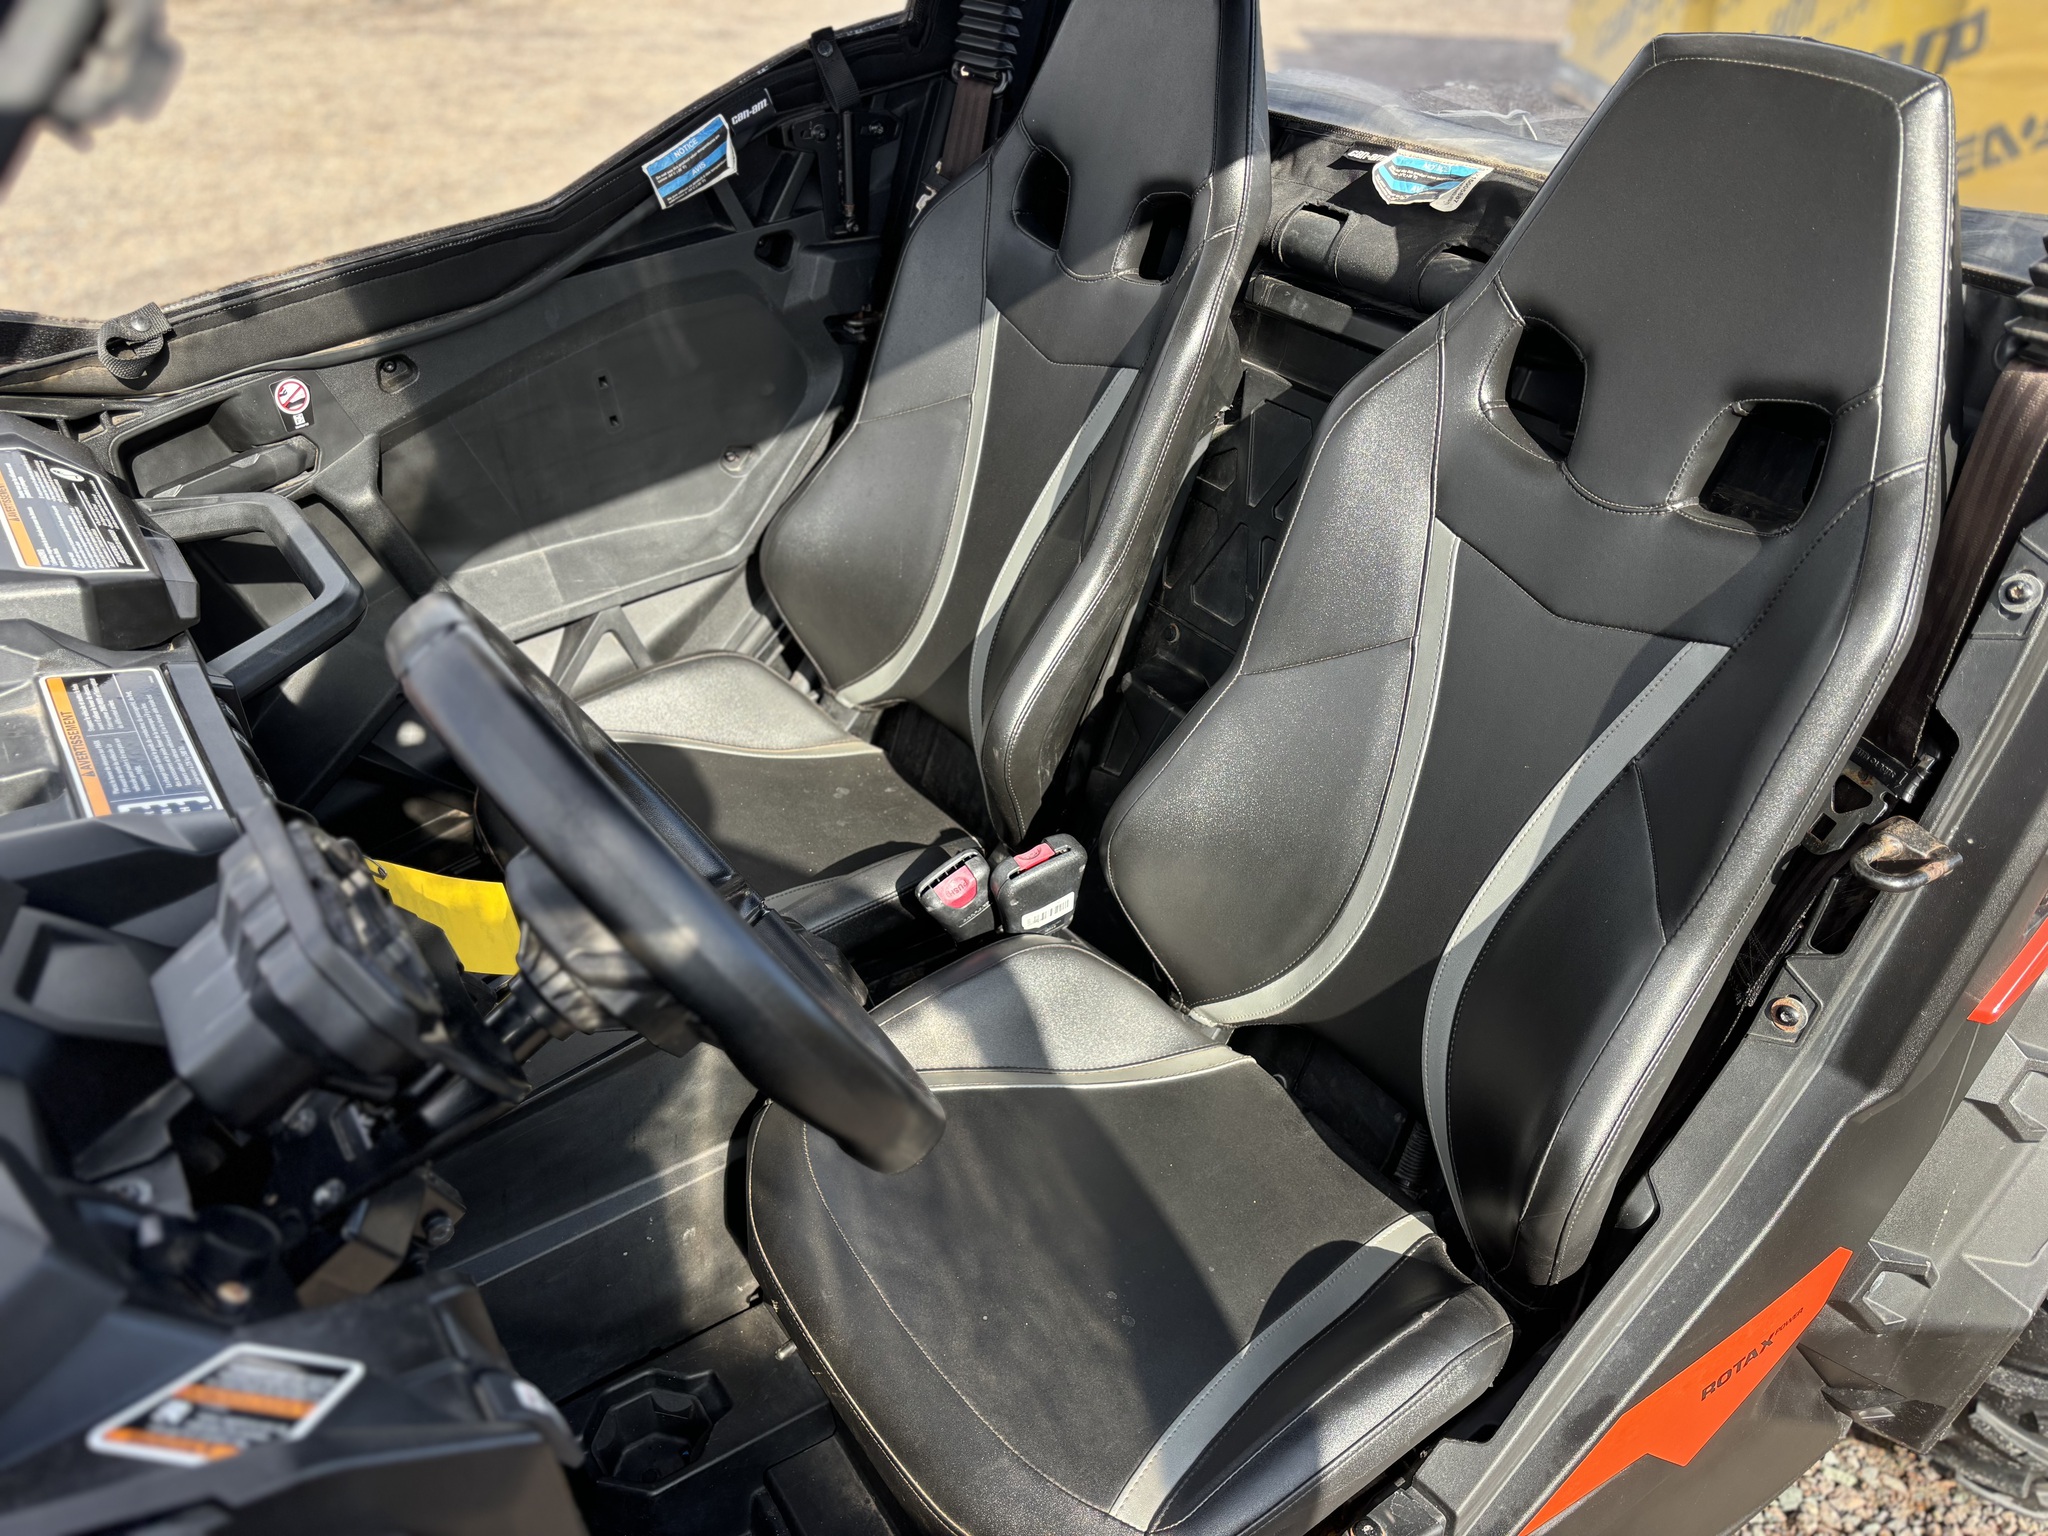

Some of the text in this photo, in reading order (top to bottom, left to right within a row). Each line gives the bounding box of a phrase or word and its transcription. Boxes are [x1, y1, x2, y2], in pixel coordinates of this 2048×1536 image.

[731, 98, 768, 125] can-am
[673, 136, 698, 158] NOTICE
[690, 160, 707, 175] AVIS
[59, 710, 92, 769] AVERTISSEMENT
[1701, 1332, 1774, 1401] ROTAX
